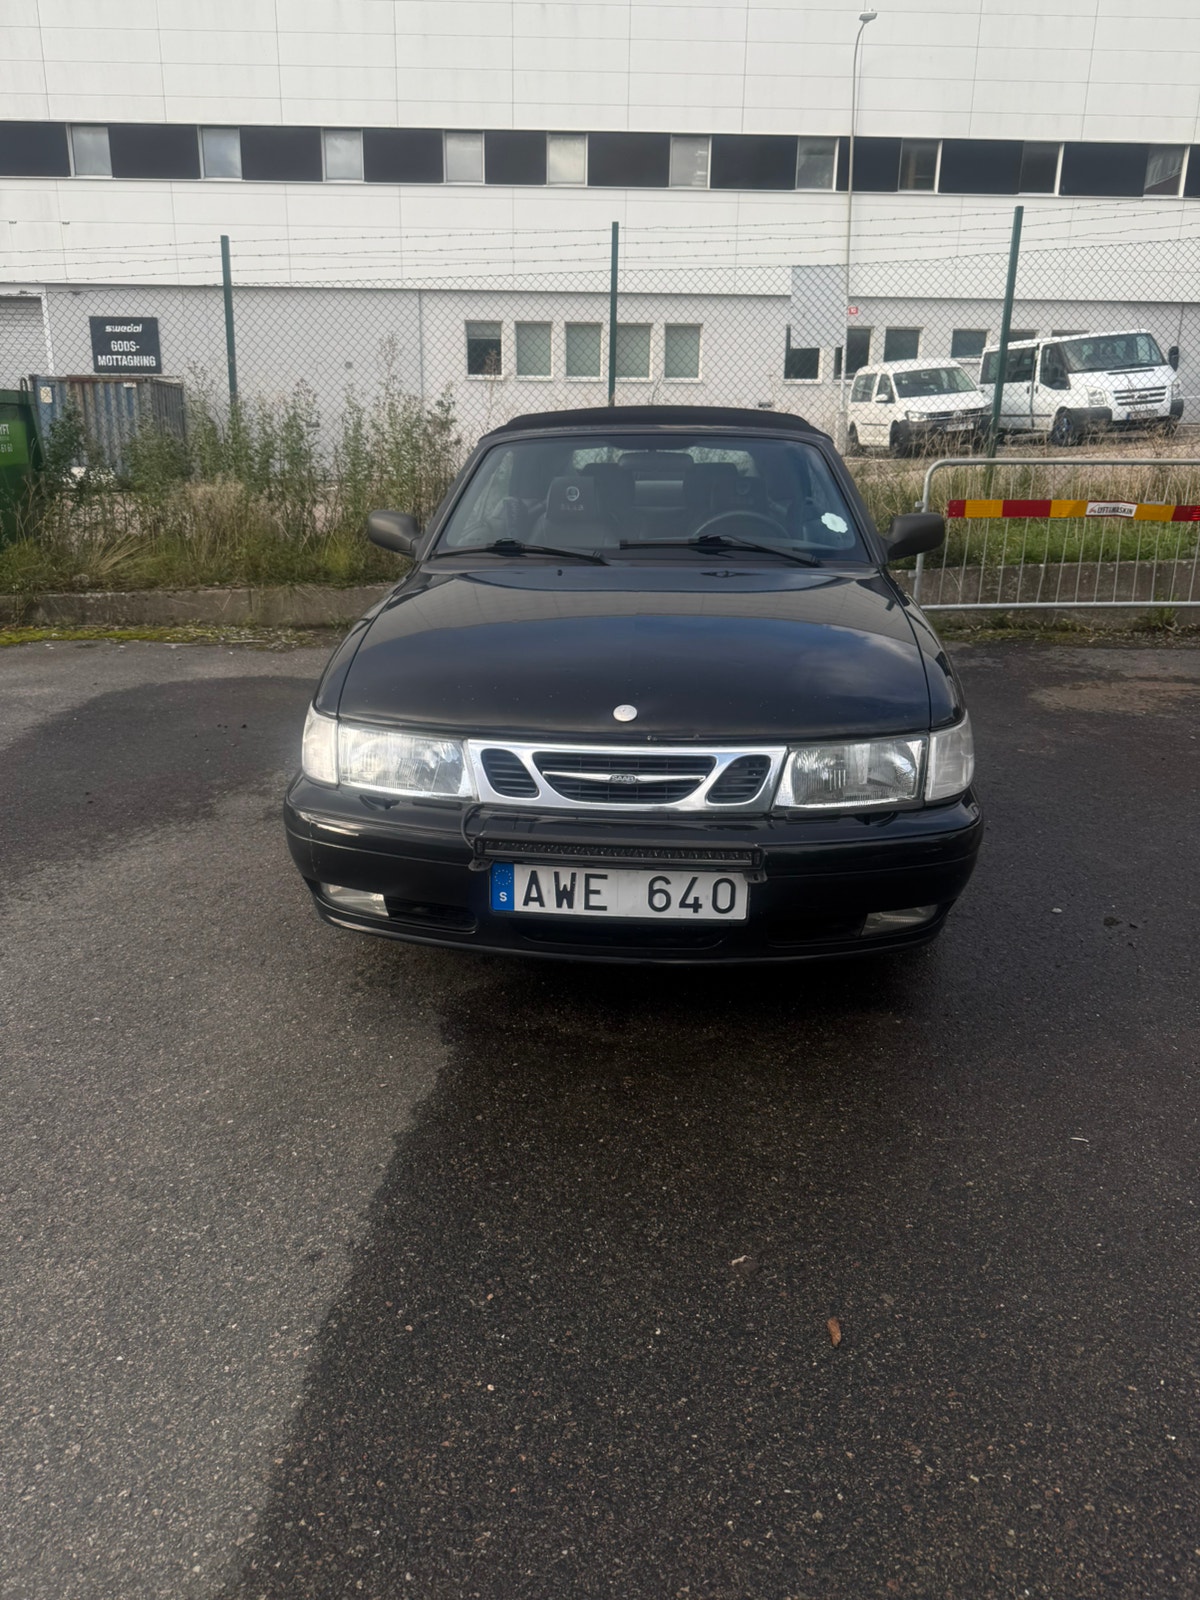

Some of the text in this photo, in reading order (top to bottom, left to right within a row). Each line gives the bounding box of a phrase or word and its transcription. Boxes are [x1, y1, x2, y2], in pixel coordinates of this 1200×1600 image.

[110, 340, 140, 352] GODS-
[97, 355, 156, 367] MOTTAGNING
[499, 891, 508, 902] S
[522, 870, 736, 914] AWE 640
